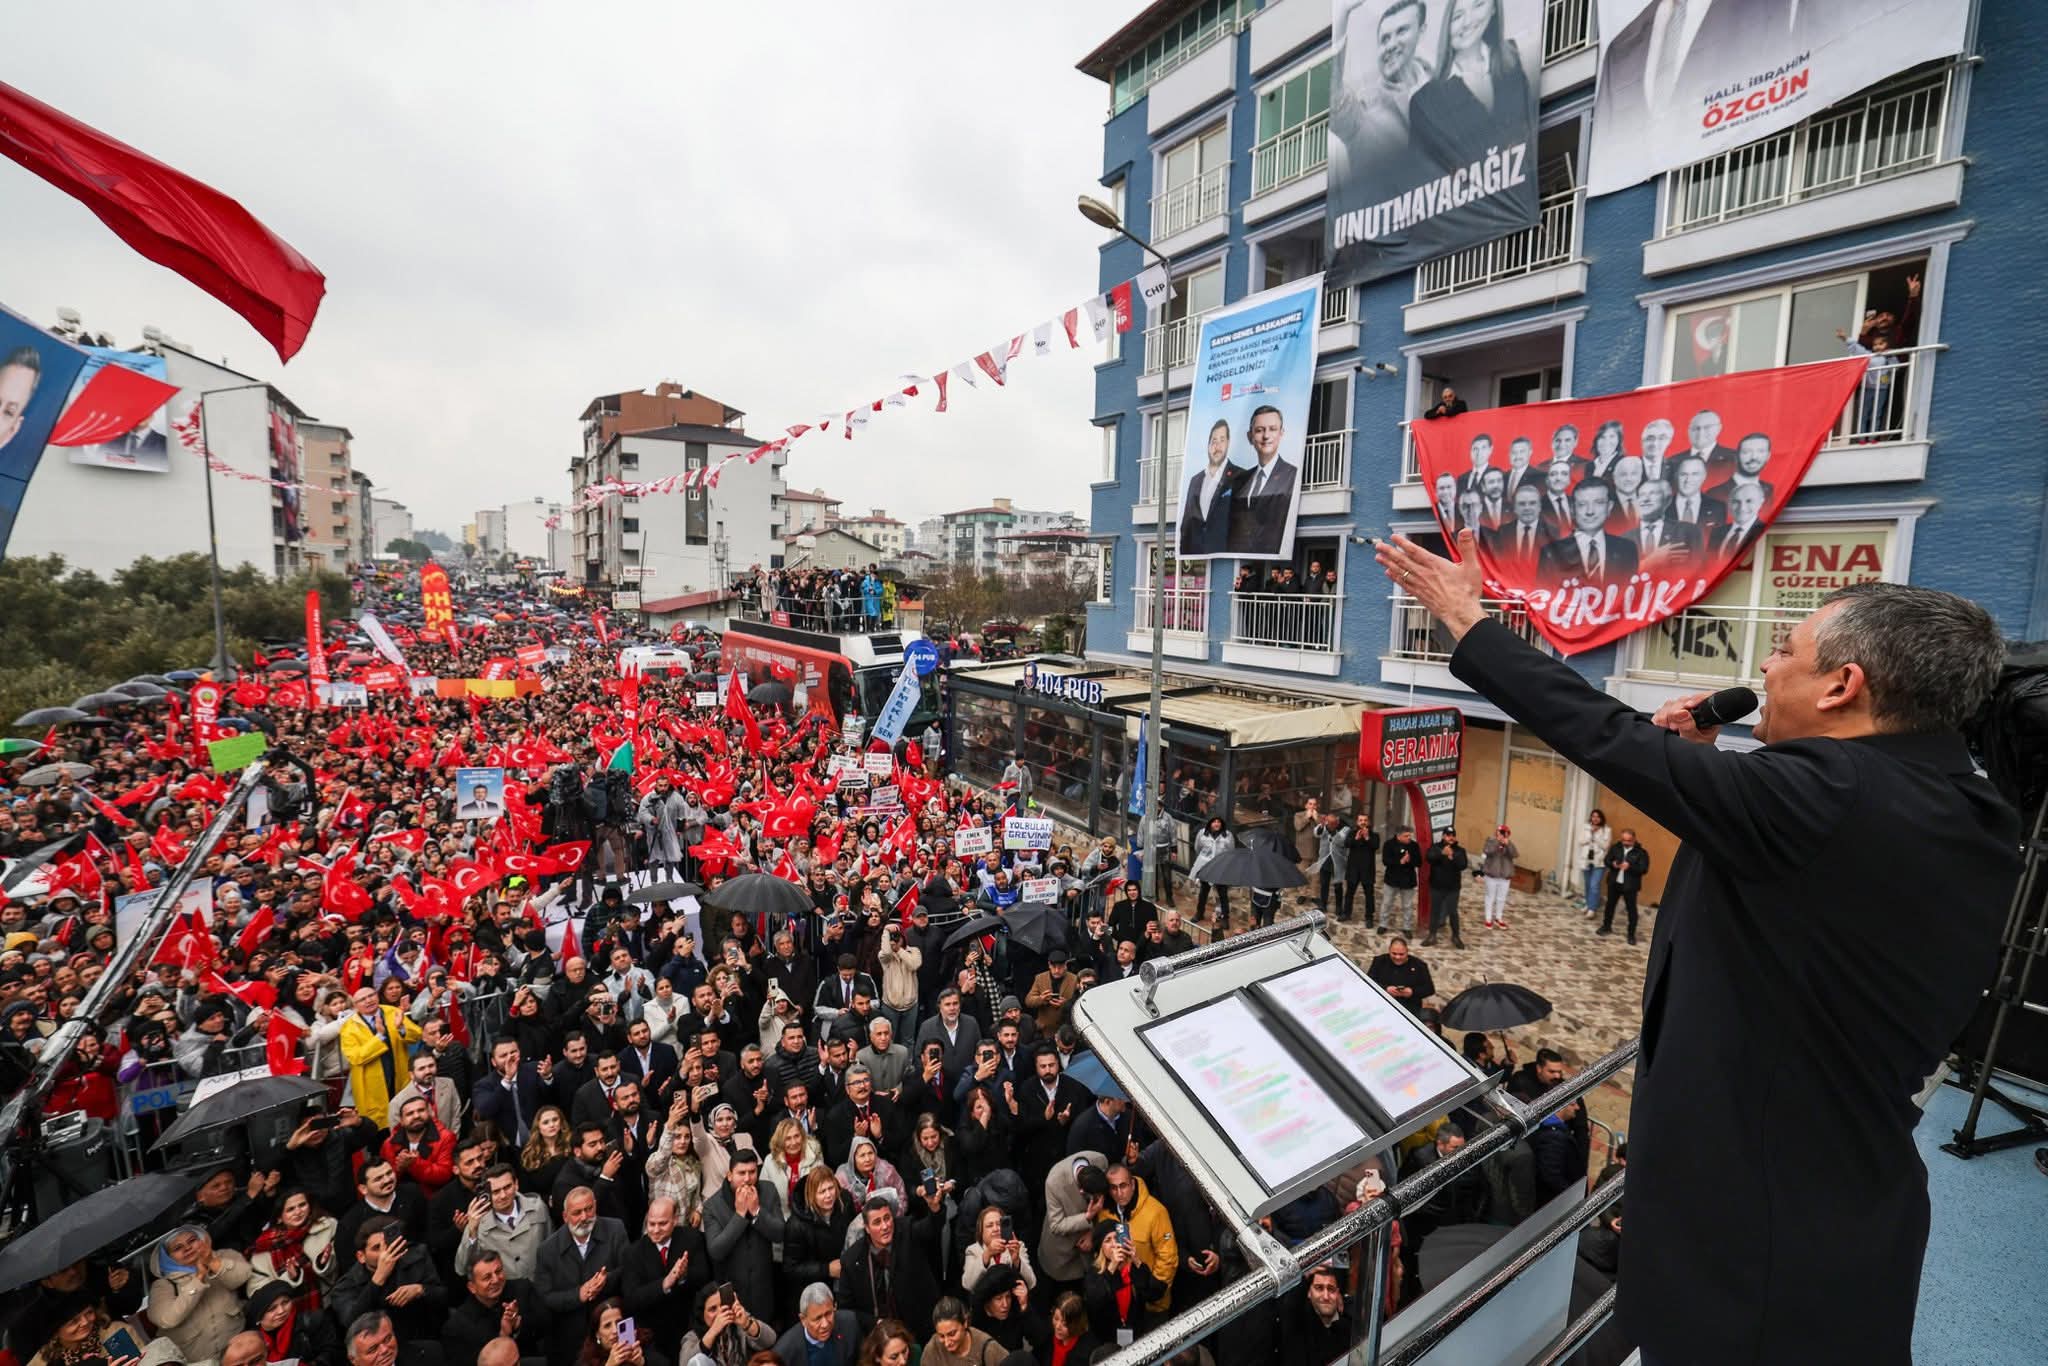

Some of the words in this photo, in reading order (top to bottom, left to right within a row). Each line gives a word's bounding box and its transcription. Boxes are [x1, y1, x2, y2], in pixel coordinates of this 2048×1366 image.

[1702, 67, 1809, 128] ÖZGÜN
[1334, 143, 1526, 249] UNUTMAYACAĞIZ
[1145, 283, 1166, 298] CHP
[1036, 672, 1064, 697] 404
[1067, 678, 1103, 704] PUB
[1383, 727, 1460, 768] SERAMİK
[1009, 821, 1051, 832] YOLBULAN
